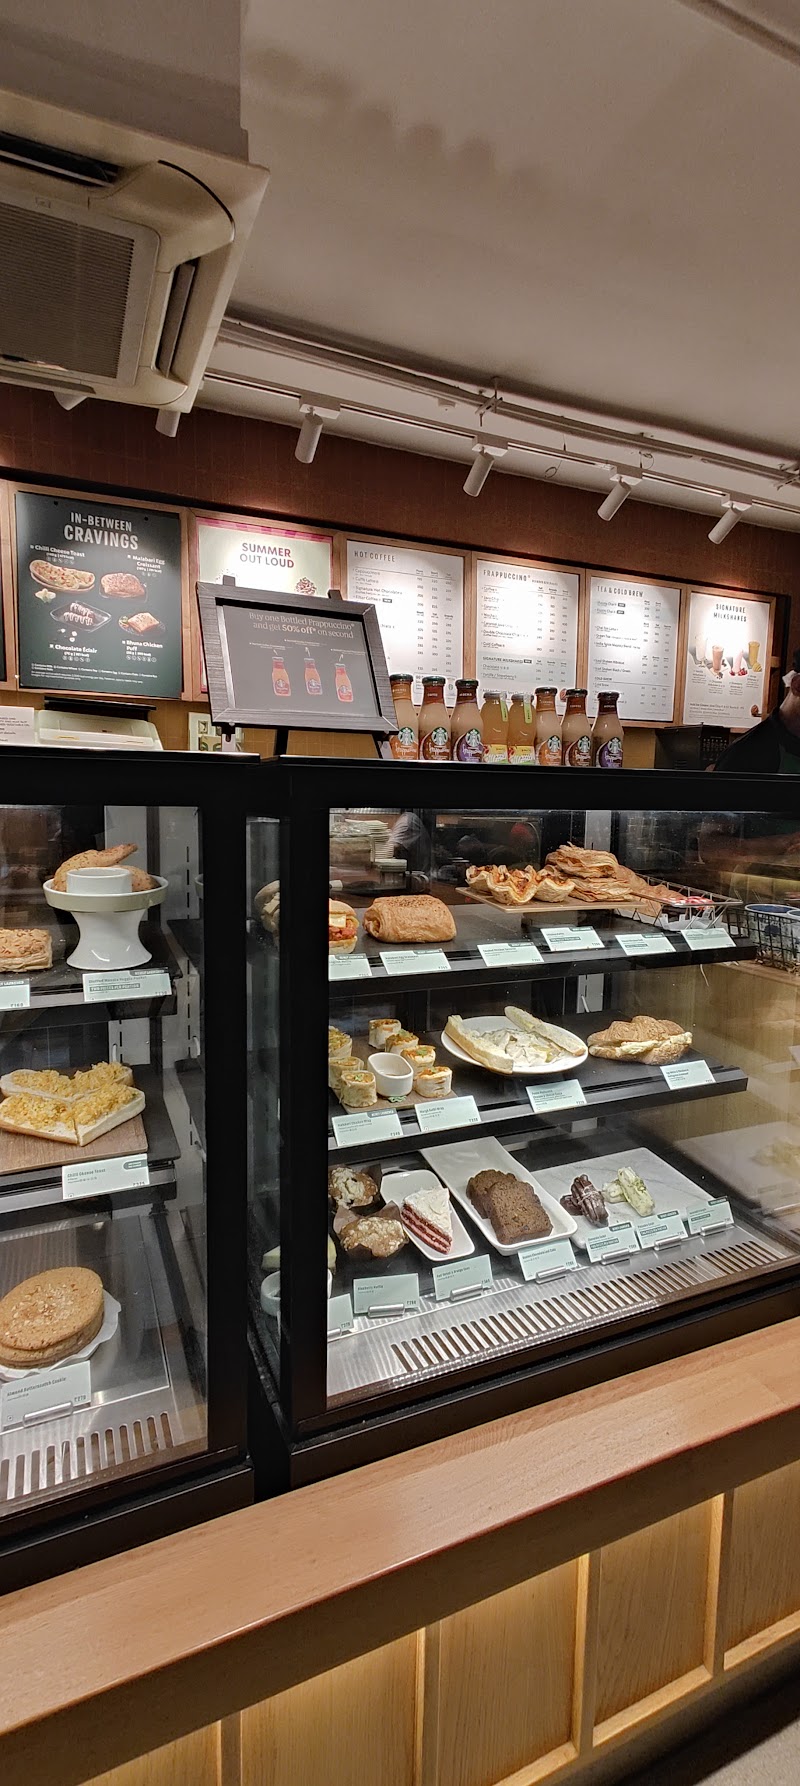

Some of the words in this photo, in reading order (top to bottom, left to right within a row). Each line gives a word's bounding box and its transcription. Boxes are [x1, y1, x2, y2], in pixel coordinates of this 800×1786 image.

[70, 512, 132, 532] IN-BETWEEN
[64, 524, 139, 550] CRAVINGS
[242, 542, 291, 557] SUMMER
[240, 553, 261, 564] OUT
[265, 557, 294, 568] LOUD
[370, 553, 395, 562] COFFEE
[716, 604, 745, 612] SIGNATURE
[249, 612, 263, 621] Buy
[280, 615, 308, 625] Bottled
[714, 612, 747, 622] MILKSHAKES
[253, 621, 267, 630] and
[268, 623, 281, 631] get
[282, 624, 300, 633] 50%
[328, 630, 354, 639] second
[55, 644, 82, 653] Chocolate
[143, 641, 163, 649] Chicken
[7, 1388, 23, 1397] Almond
[23, 1381, 52, 1392] Butterscotch
[52, 1377, 66, 1385] Cookie
